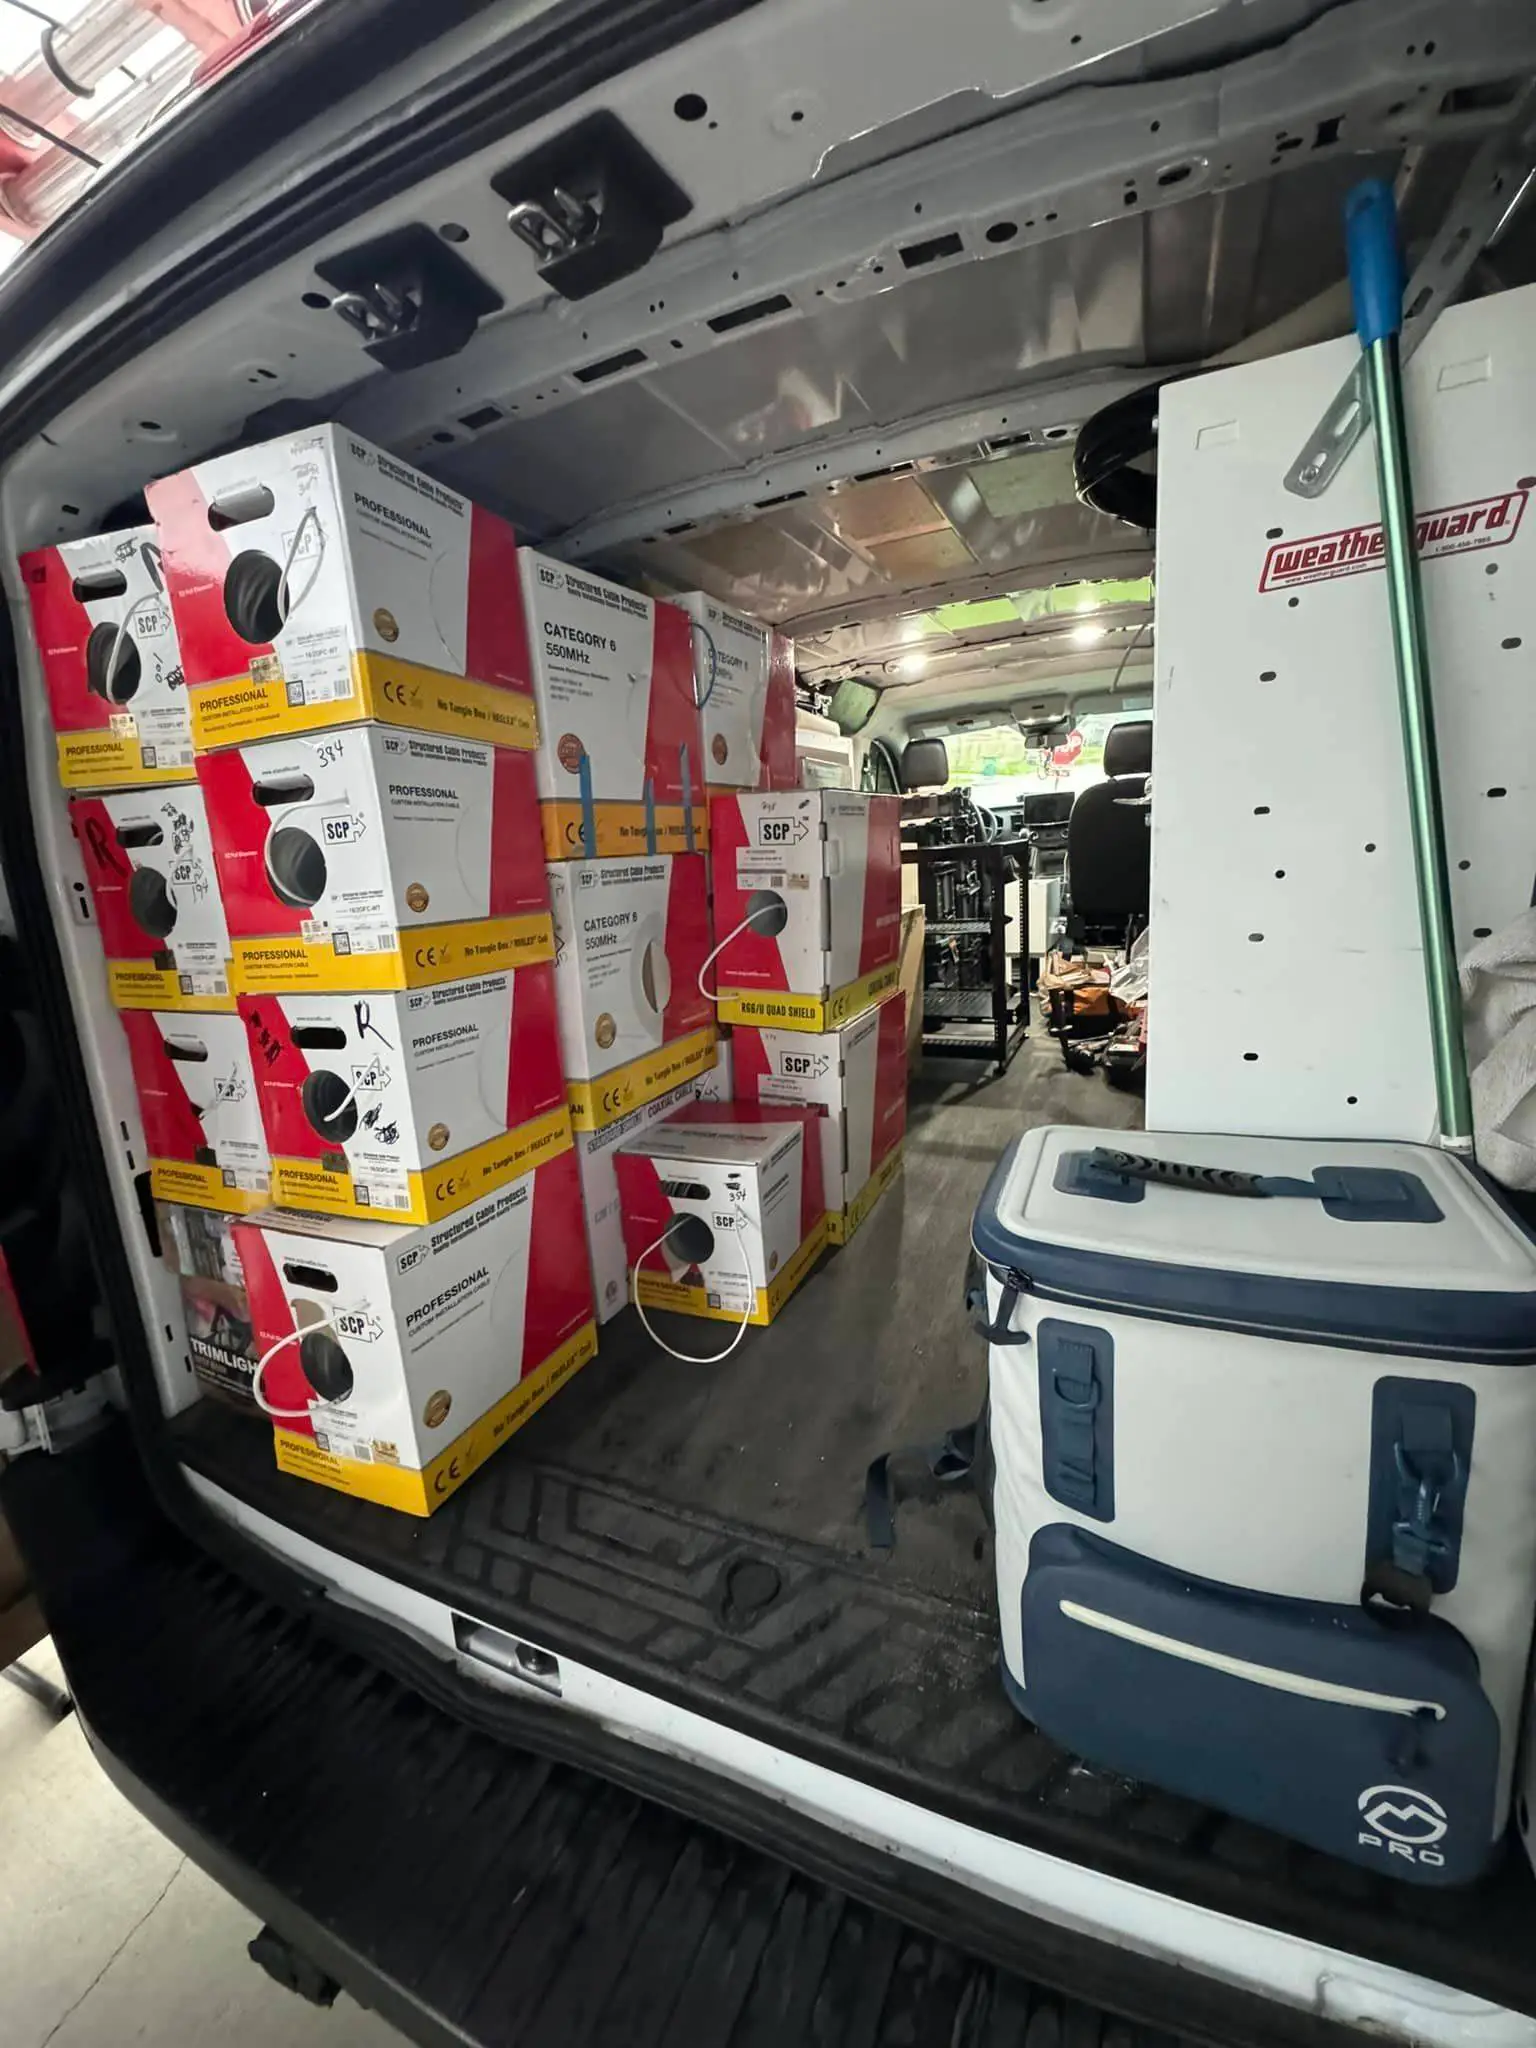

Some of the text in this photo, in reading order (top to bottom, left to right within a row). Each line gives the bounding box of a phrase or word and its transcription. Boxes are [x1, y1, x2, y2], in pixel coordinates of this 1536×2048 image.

[354, 491, 431, 539] PROFESSIONAL
[138, 615, 157, 633] SCP
[543, 621, 617, 652] CATEGORY 6
[546, 642, 591, 664] 550MHz
[200, 689, 268, 712] PROFESSIONAL
[66, 742, 123, 757] PROFESSIONAL
[317, 740, 344, 768] 384
[384, 740, 399, 752] SCP
[388, 784, 459, 799] PROFESSIONAL
[327, 823, 349, 840] SCP
[764, 823, 790, 841] SCP
[584, 911, 638, 932] CATEGORY 6
[585, 933, 618, 950] 550MHz
[242, 949, 308, 961] PROFESSIONAL
[431, 983, 465, 1000] Structured
[465, 979, 481, 993] Cable
[409, 997, 423, 1009] SCP
[766, 1003, 786, 1017] QUAD
[788, 1004, 815, 1020] SHIELD
[412, 1023, 479, 1049] PROFESSIONAL
[785, 1056, 810, 1074] SCP
[648, 1094, 674, 1118] COAXIAL
[279, 1169, 339, 1186] PROFESSIONAL
[431, 1187, 528, 1248] Structured Cable Products
[716, 1215, 734, 1228] SCP
[400, 1250, 418, 1271] SCP
[405, 1265, 489, 1328] PROFESSIONAL
[340, 1314, 365, 1336] SCP
[280, 1438, 341, 1467] PROFESSIONAL
[1358, 1831, 1445, 1867] PRO
